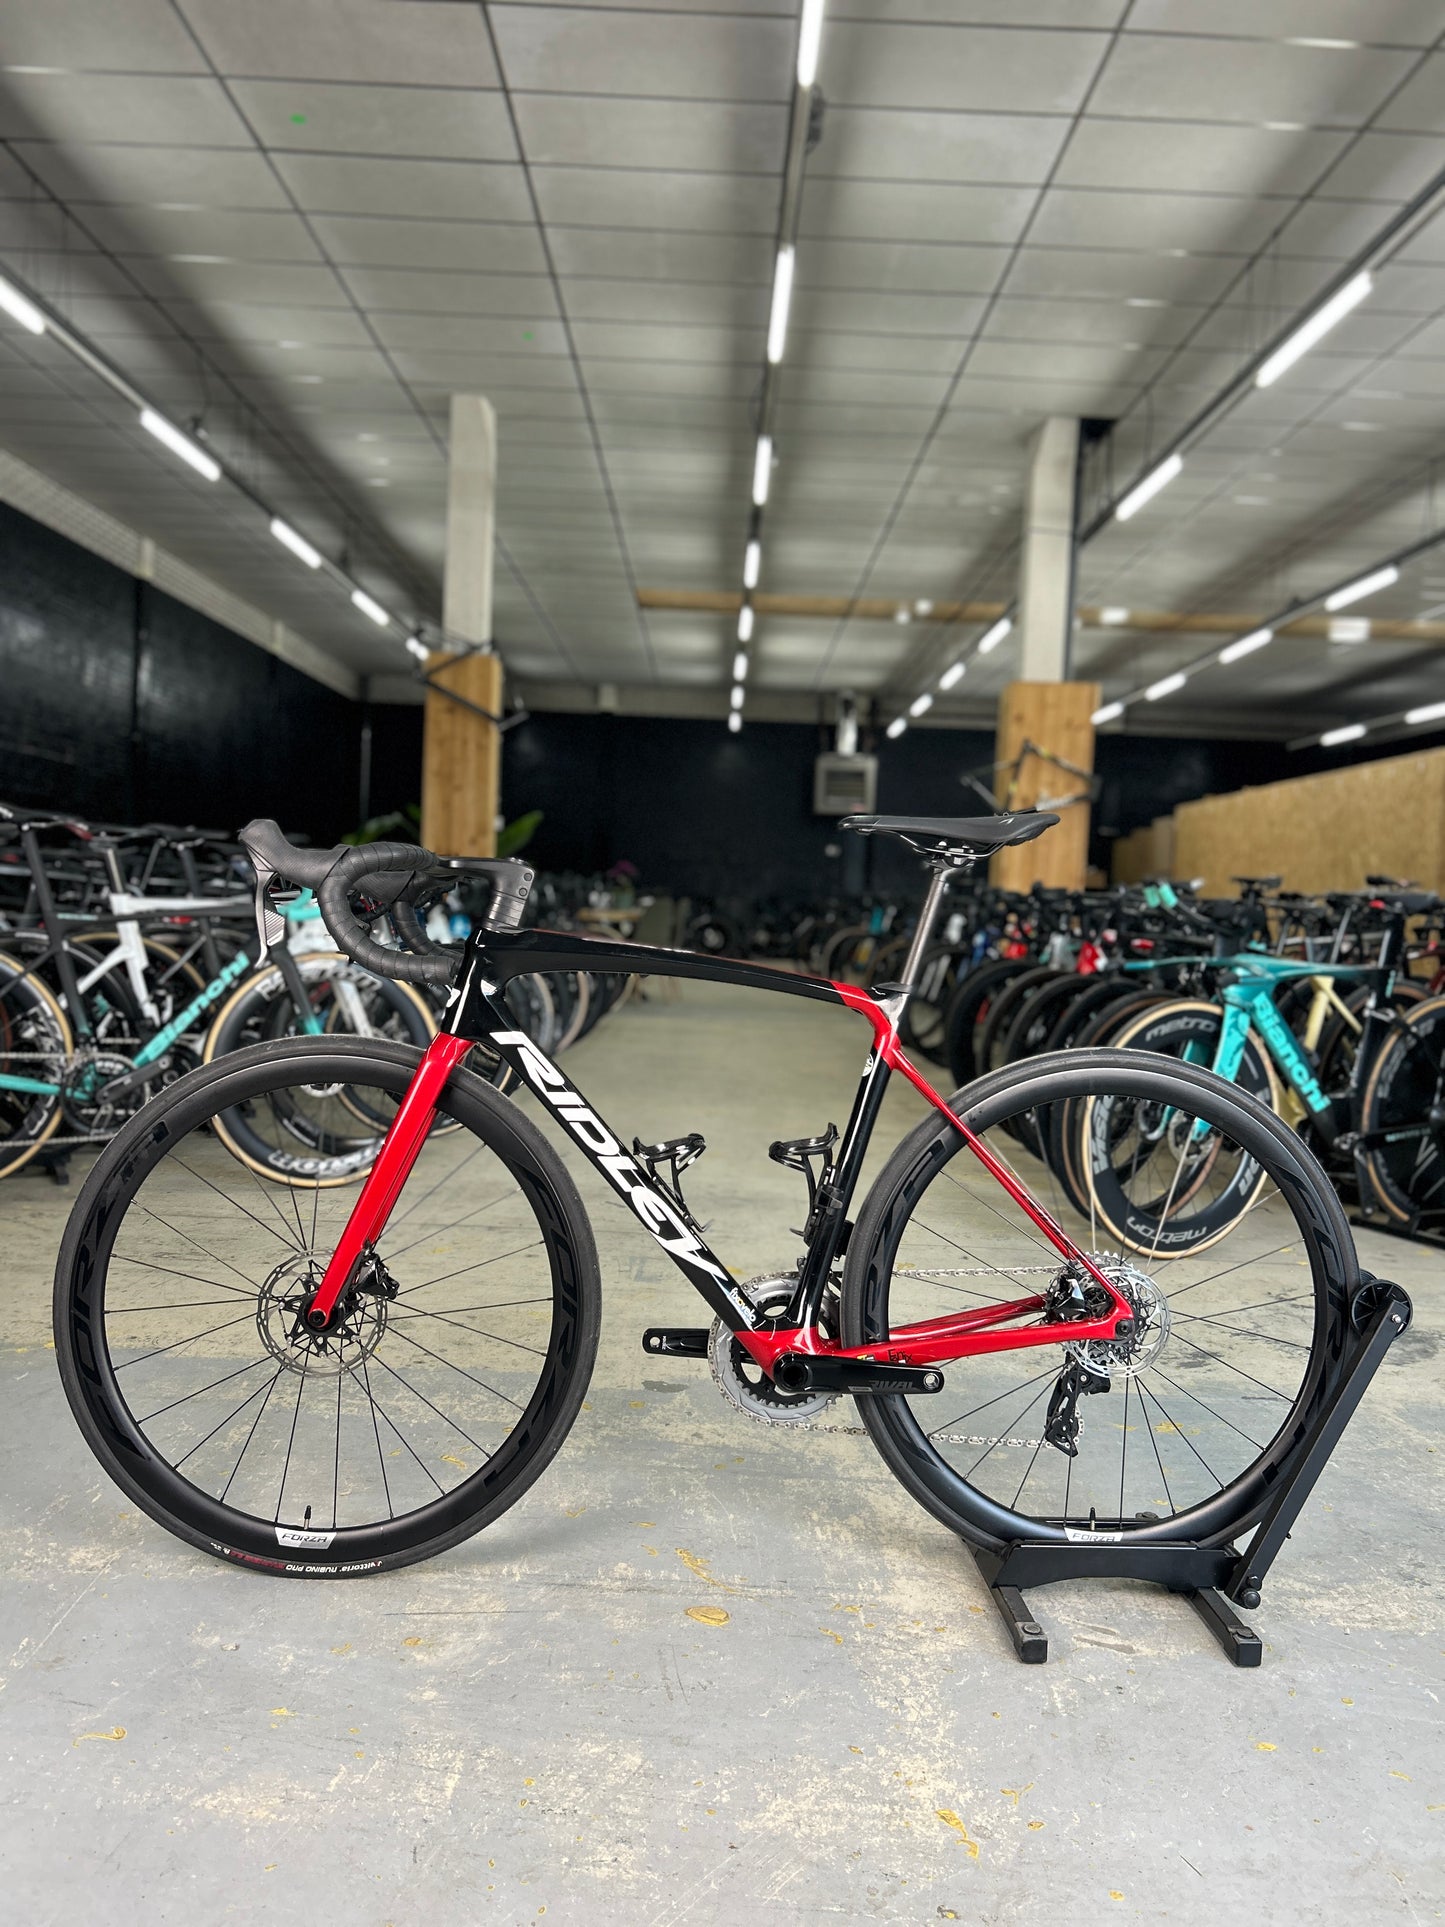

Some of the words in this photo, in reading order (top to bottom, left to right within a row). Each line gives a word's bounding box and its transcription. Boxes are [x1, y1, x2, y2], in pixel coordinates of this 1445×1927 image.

[1145, 1016, 1217, 1041] metro
[1252, 991, 1332, 1113] Bianchi
[1092, 1094, 1115, 1176] VISIO
[489, 1030, 729, 1282] RIDLEY
[1126, 1216, 1208, 1244] metron
[281, 1532, 329, 1544] FORZA
[1072, 1531, 1115, 1542] FORZA
